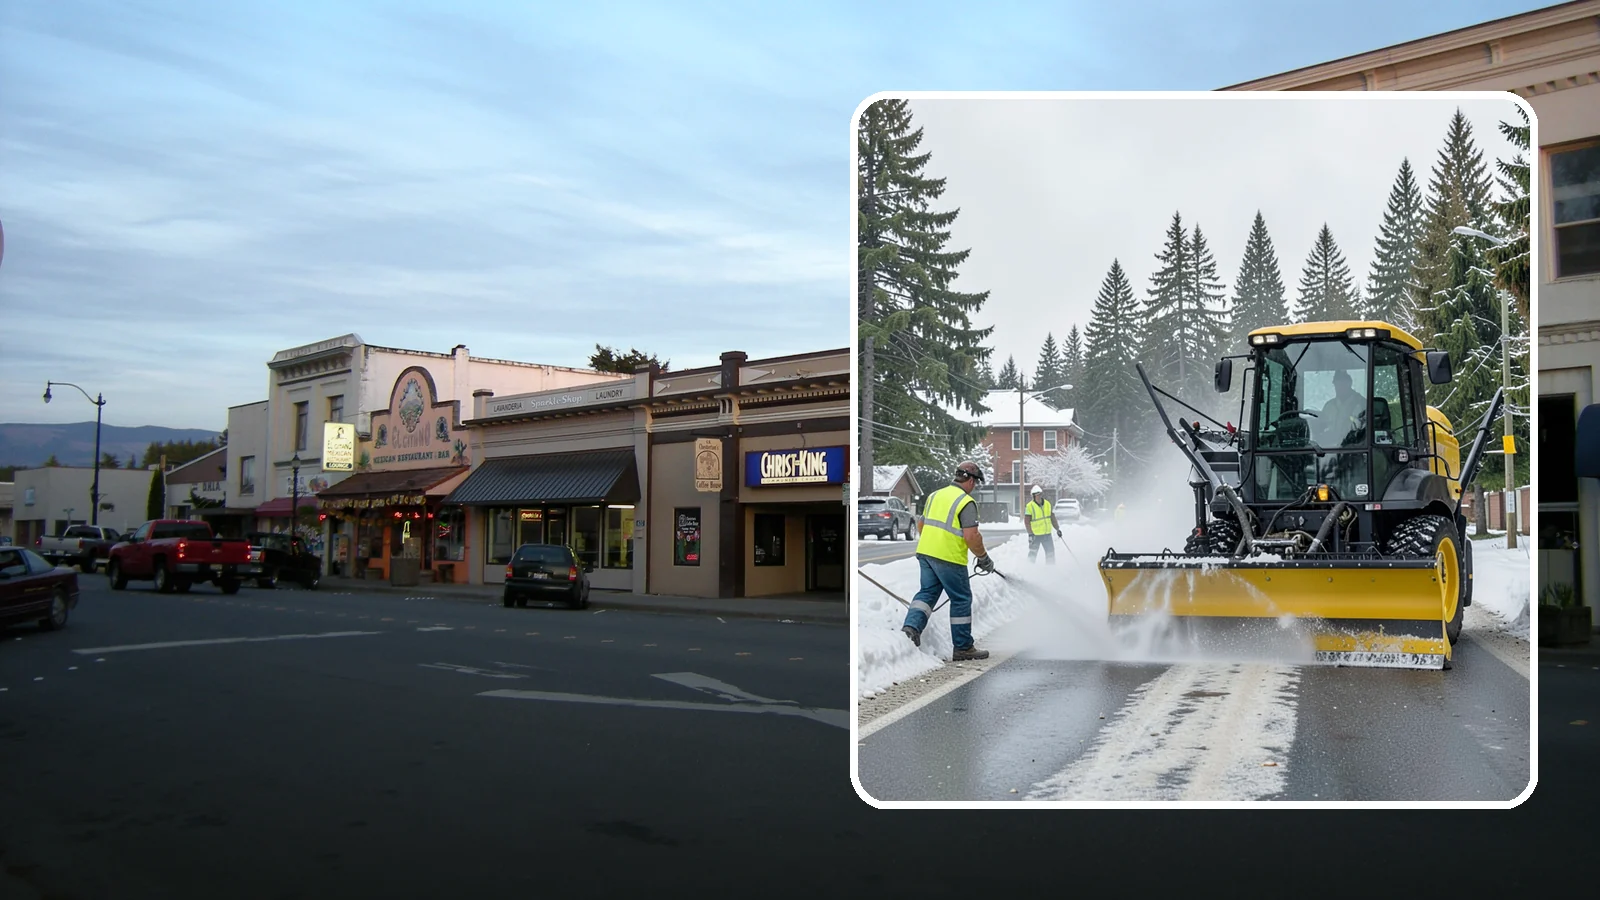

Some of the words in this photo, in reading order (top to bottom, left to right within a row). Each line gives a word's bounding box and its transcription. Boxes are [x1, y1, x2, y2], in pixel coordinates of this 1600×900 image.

[595, 389, 623, 399] LAUNDRY
[493, 402, 522, 413] LAVANDERIA
[530, 398, 560, 409] Sparkle
[561, 394, 582, 404] Shop
[373, 454, 396, 464] MEXICAN
[397, 451, 434, 462] RESTAURANT
[438, 450, 450, 459] BAR
[761, 452, 797, 478] CHRIST
[799, 450, 827, 476] KING
